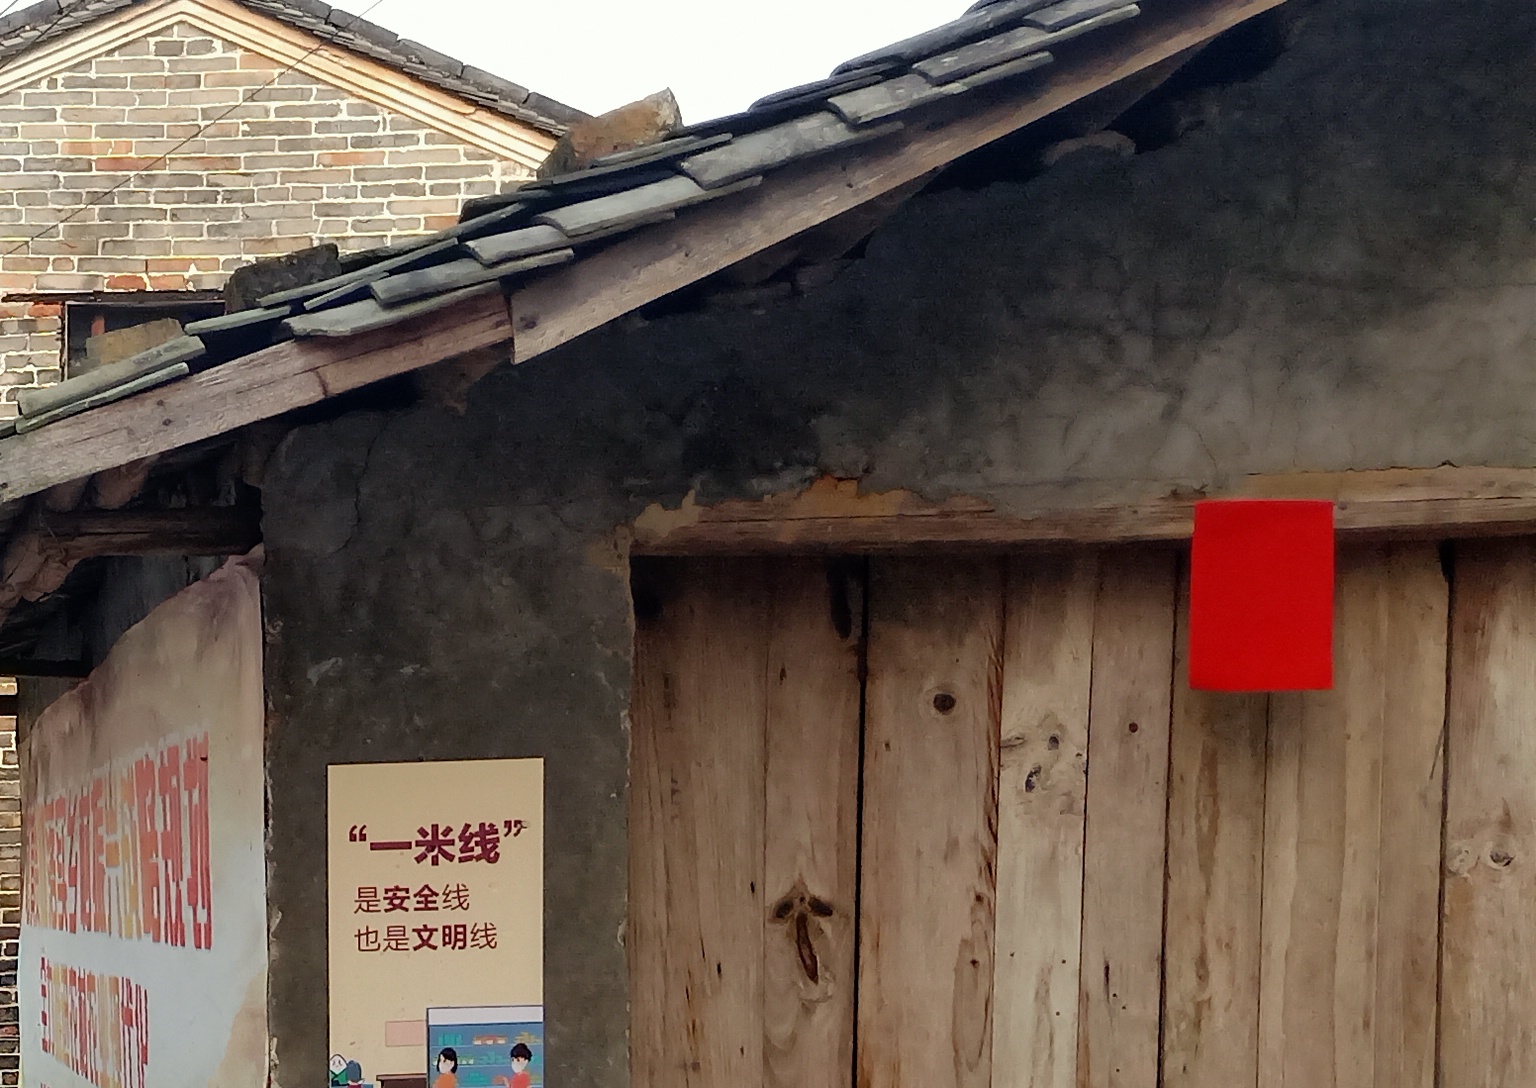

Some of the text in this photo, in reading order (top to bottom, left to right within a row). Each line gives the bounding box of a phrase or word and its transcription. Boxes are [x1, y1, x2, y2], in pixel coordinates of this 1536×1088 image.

[353, 884, 470, 915] 是安全线
[353, 922, 499, 954] 也是文明线
